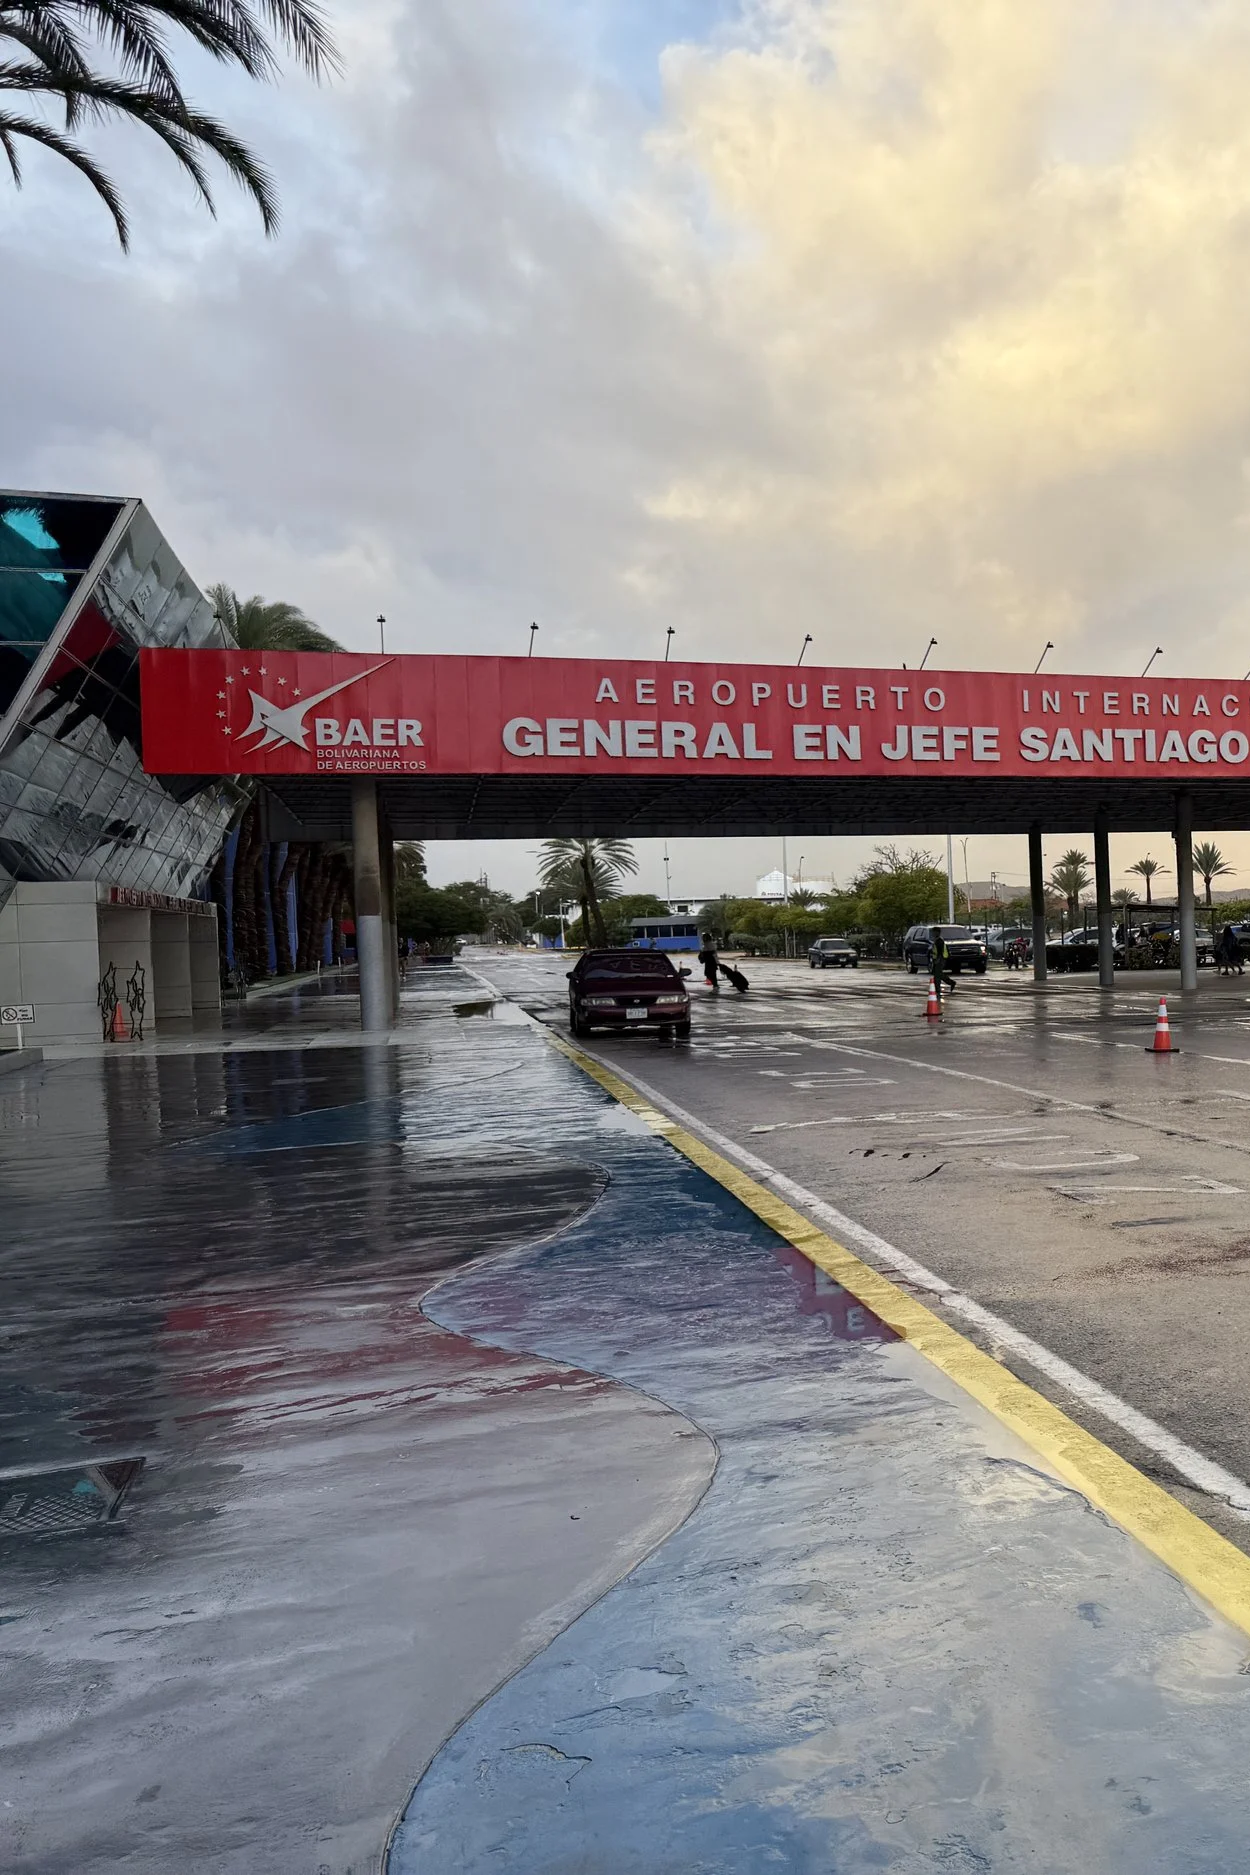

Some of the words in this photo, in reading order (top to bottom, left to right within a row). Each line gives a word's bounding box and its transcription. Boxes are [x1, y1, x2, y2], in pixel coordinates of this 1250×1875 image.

[595, 678, 946, 712] AEROPUERTO
[315, 717, 425, 746] BAER
[502, 717, 773, 760] GENERAL
[793, 724, 862, 761] EN
[881, 725, 1001, 762] JEFE
[1019, 727, 1250, 764] SANTIAGO
[316, 749, 400, 758] BOLIVARIANA
[317, 761, 333, 770] DE
[335, 761, 427, 770] AEROPUERTOS
